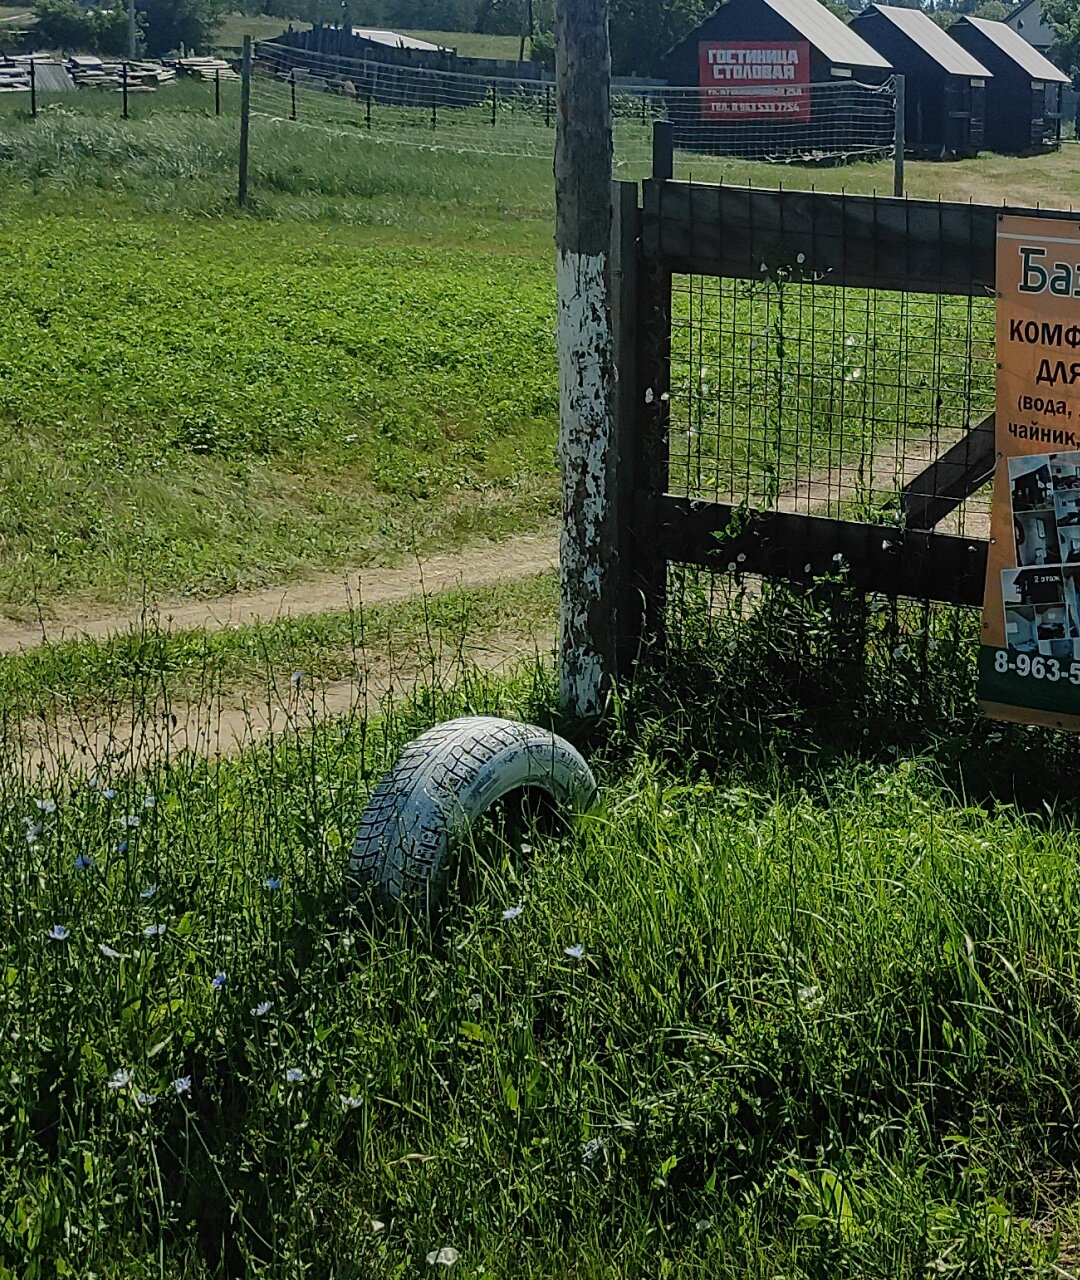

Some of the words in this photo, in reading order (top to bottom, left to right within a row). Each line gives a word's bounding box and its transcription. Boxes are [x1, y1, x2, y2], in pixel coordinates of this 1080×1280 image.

[708, 49, 799, 64] ГОСТИНИЦА
[713, 65, 795, 79] СТОЛОВАЯ
[1017, 394, 1073, 418] (вода,
[1008, 422, 1080, 450] чайник,
